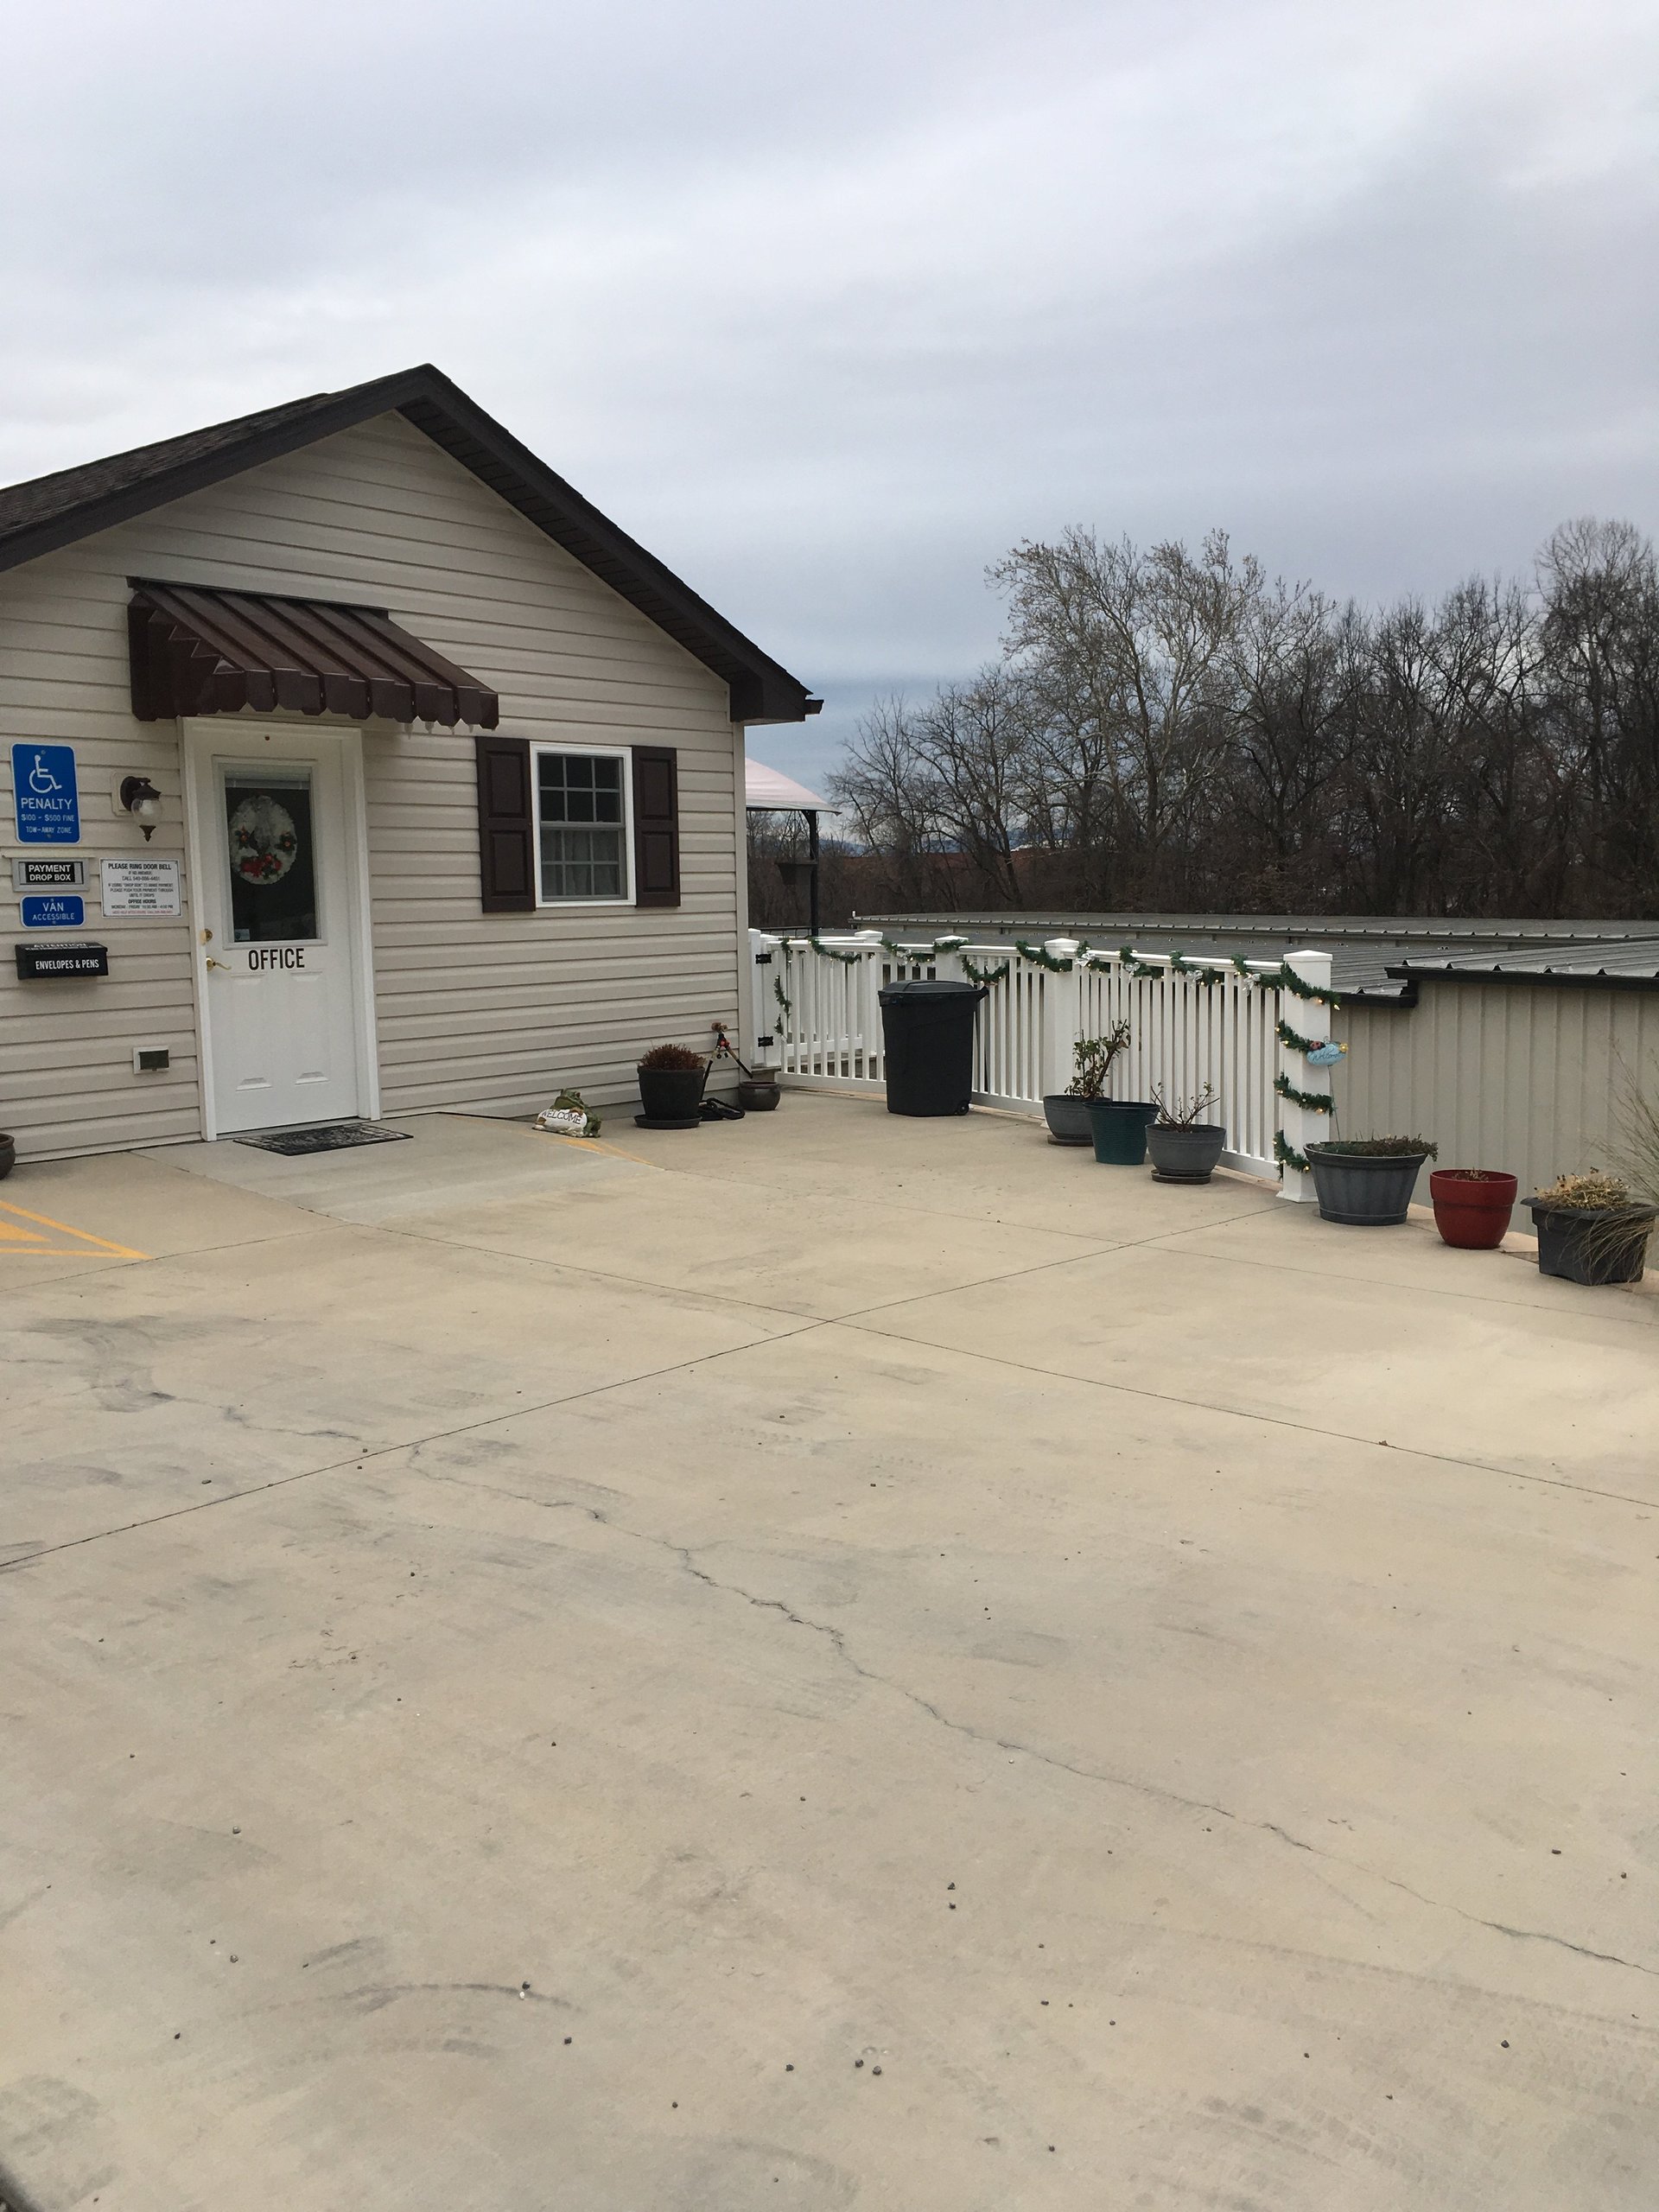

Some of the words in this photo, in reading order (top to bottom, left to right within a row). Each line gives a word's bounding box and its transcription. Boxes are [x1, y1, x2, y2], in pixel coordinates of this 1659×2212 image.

[21, 798, 73, 810] PENALTY
[28, 864, 72, 873] PAYMENT
[42, 902, 64, 912] VAN
[32, 912, 75, 921] ACCESSIBLE
[35, 960, 73, 970] ENVELOPES
[75, 960, 80, 969] &
[81, 959, 99, 969] PENS
[248, 948, 305, 970] OFFICE
[542, 1111, 582, 1124] WELCOME
